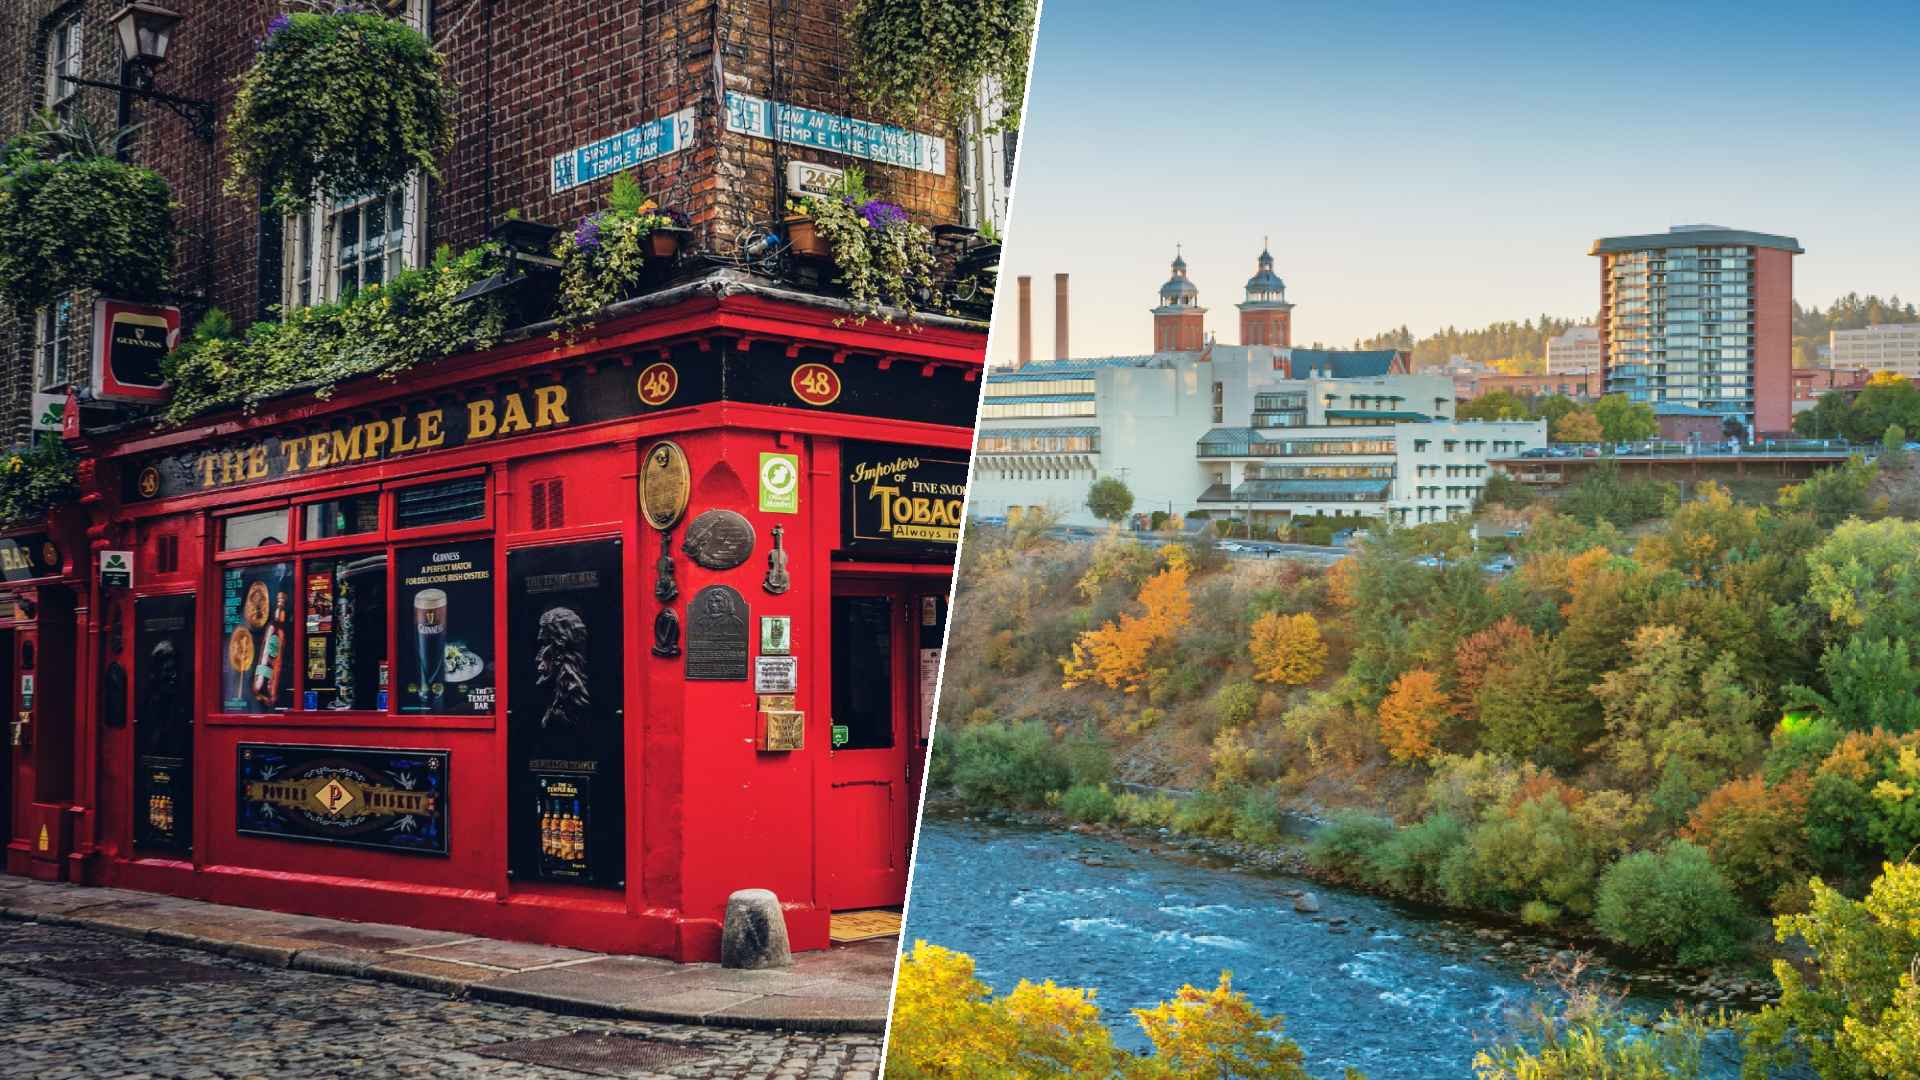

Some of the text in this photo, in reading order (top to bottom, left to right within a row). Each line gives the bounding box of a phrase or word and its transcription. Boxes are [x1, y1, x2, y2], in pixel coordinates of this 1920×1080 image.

[808, 115, 824, 129] AN
[776, 124, 826, 146] TEMPE
[831, 134, 865, 153] LNE
[592, 151, 632, 175] TEMPLE
[636, 143, 659, 160] BAR
[116, 336, 162, 349] GUINNESS
[645, 371, 670, 398] 48
[801, 369, 831, 395] 48
[199, 385, 571, 487] THE TEMPLE BAR
[850, 456, 920, 485] Importers
[894, 474, 907, 482] OF
[912, 481, 938, 495] FINE
[896, 525, 941, 538] Always
[0, 546, 35, 570] BAR
[432, 552, 460, 562] GUINNESS
[427, 563, 450, 573] PERFECT
[451, 561, 472, 571] MATCH
[463, 571, 489, 580] OYSTERS
[467, 694, 496, 702] TEMPLE
[474, 702, 489, 710] BAR
